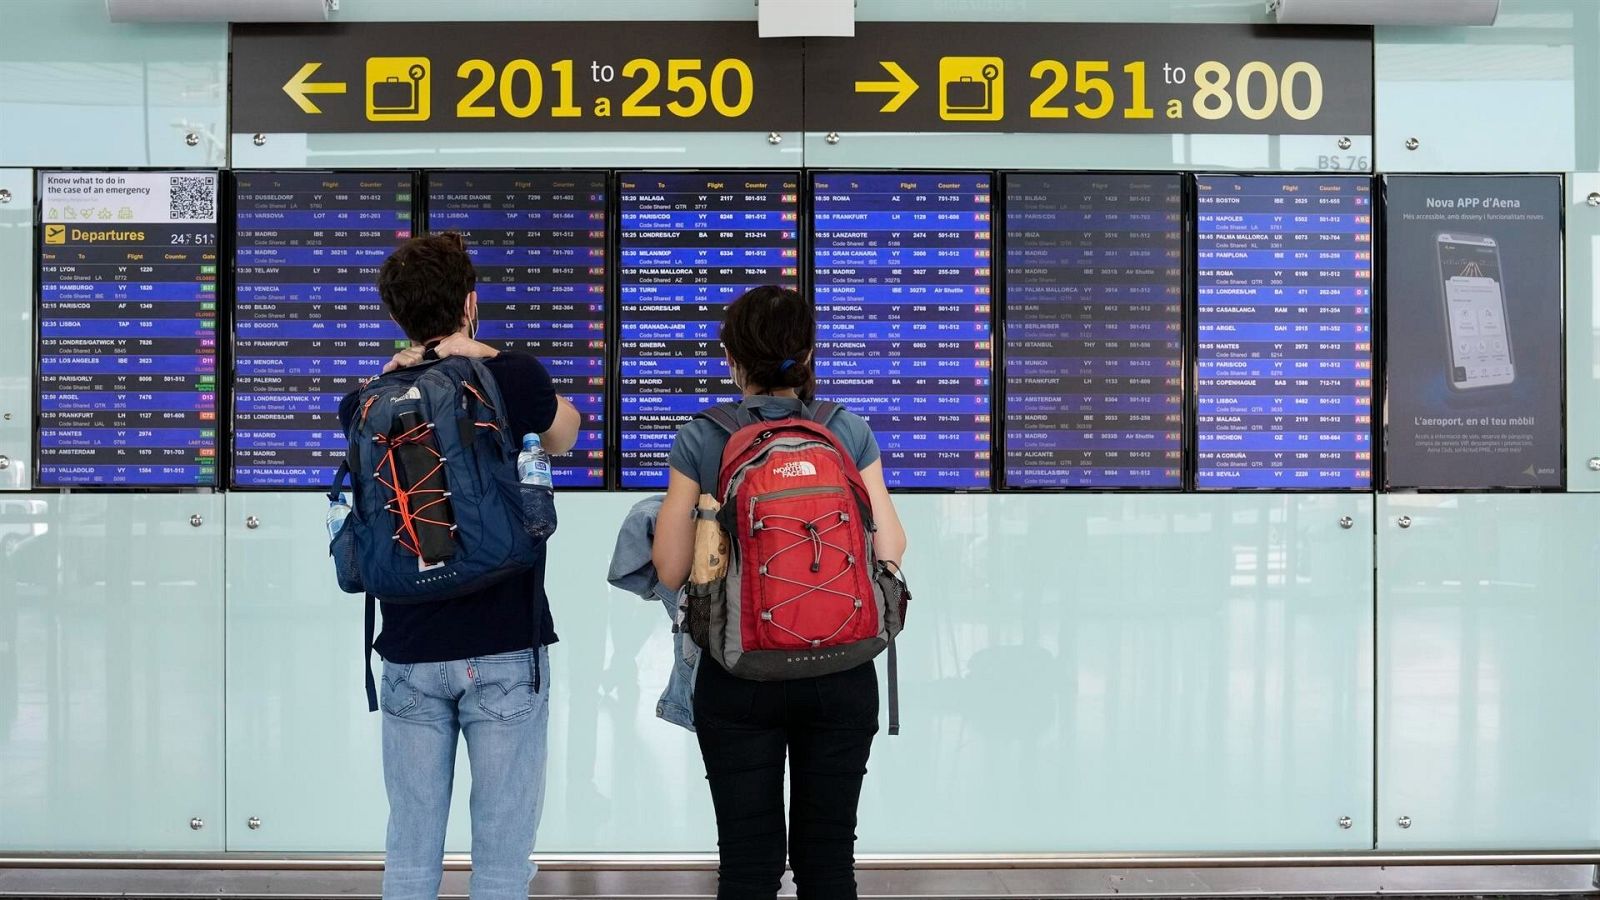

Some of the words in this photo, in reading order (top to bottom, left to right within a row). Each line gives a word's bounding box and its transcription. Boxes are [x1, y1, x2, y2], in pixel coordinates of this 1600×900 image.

[590, 60, 615, 83] to
[1162, 62, 1186, 84] to
[456, 58, 582, 118] 201
[621, 58, 754, 118] 250
[1029, 59, 1154, 119] 251
[1192, 60, 1323, 120] 800
[594, 96, 611, 117] a
[1166, 98, 1183, 119] a
[1317, 155, 1341, 170] BS
[1346, 155, 1368, 170] 76
[48, 186, 61, 194] the
[83, 186, 92, 194] of
[106, 187, 151, 196] emergency
[707, 182, 724, 190] Flight
[1426, 197, 1454, 208] Nova
[1457, 198, 1480, 208] APP
[71, 229, 145, 243] Departures
[127, 253, 144, 261] Flight
[1466, 418, 1478, 426] en
[1480, 417, 1489, 426] el
[1491, 417, 1507, 426] teu
[1509, 416, 1535, 426] mòbil
